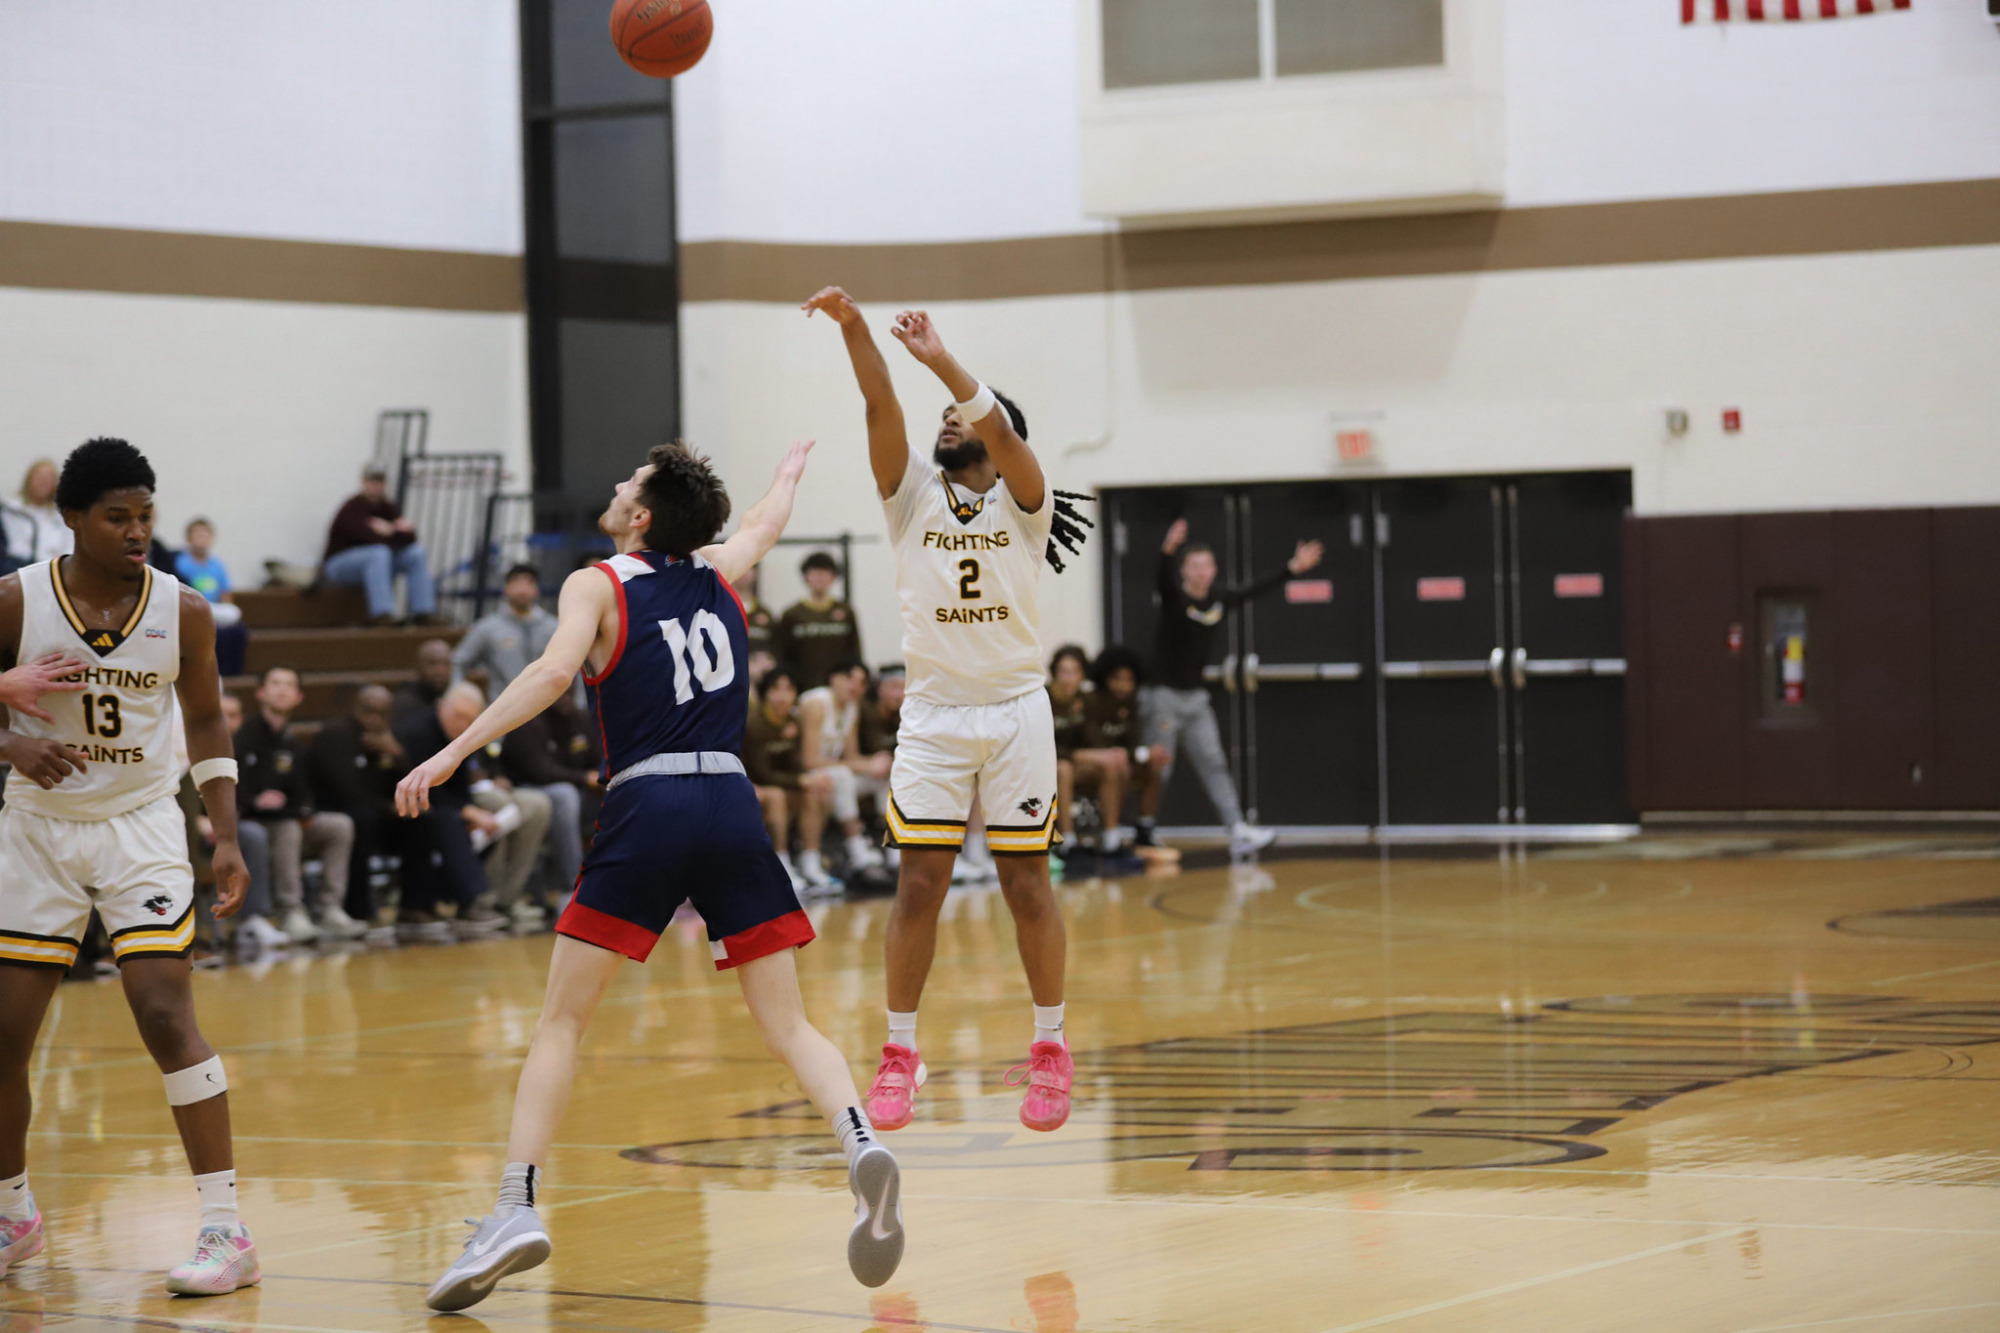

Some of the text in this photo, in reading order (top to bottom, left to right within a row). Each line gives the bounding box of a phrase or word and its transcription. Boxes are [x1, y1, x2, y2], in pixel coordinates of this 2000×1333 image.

[923, 531, 1010, 551] FIGHTING
[958, 558, 982, 600] 2
[57, 666, 159, 689] GHTING
[657, 608, 735, 706] 10
[82, 693, 122, 738] 13
